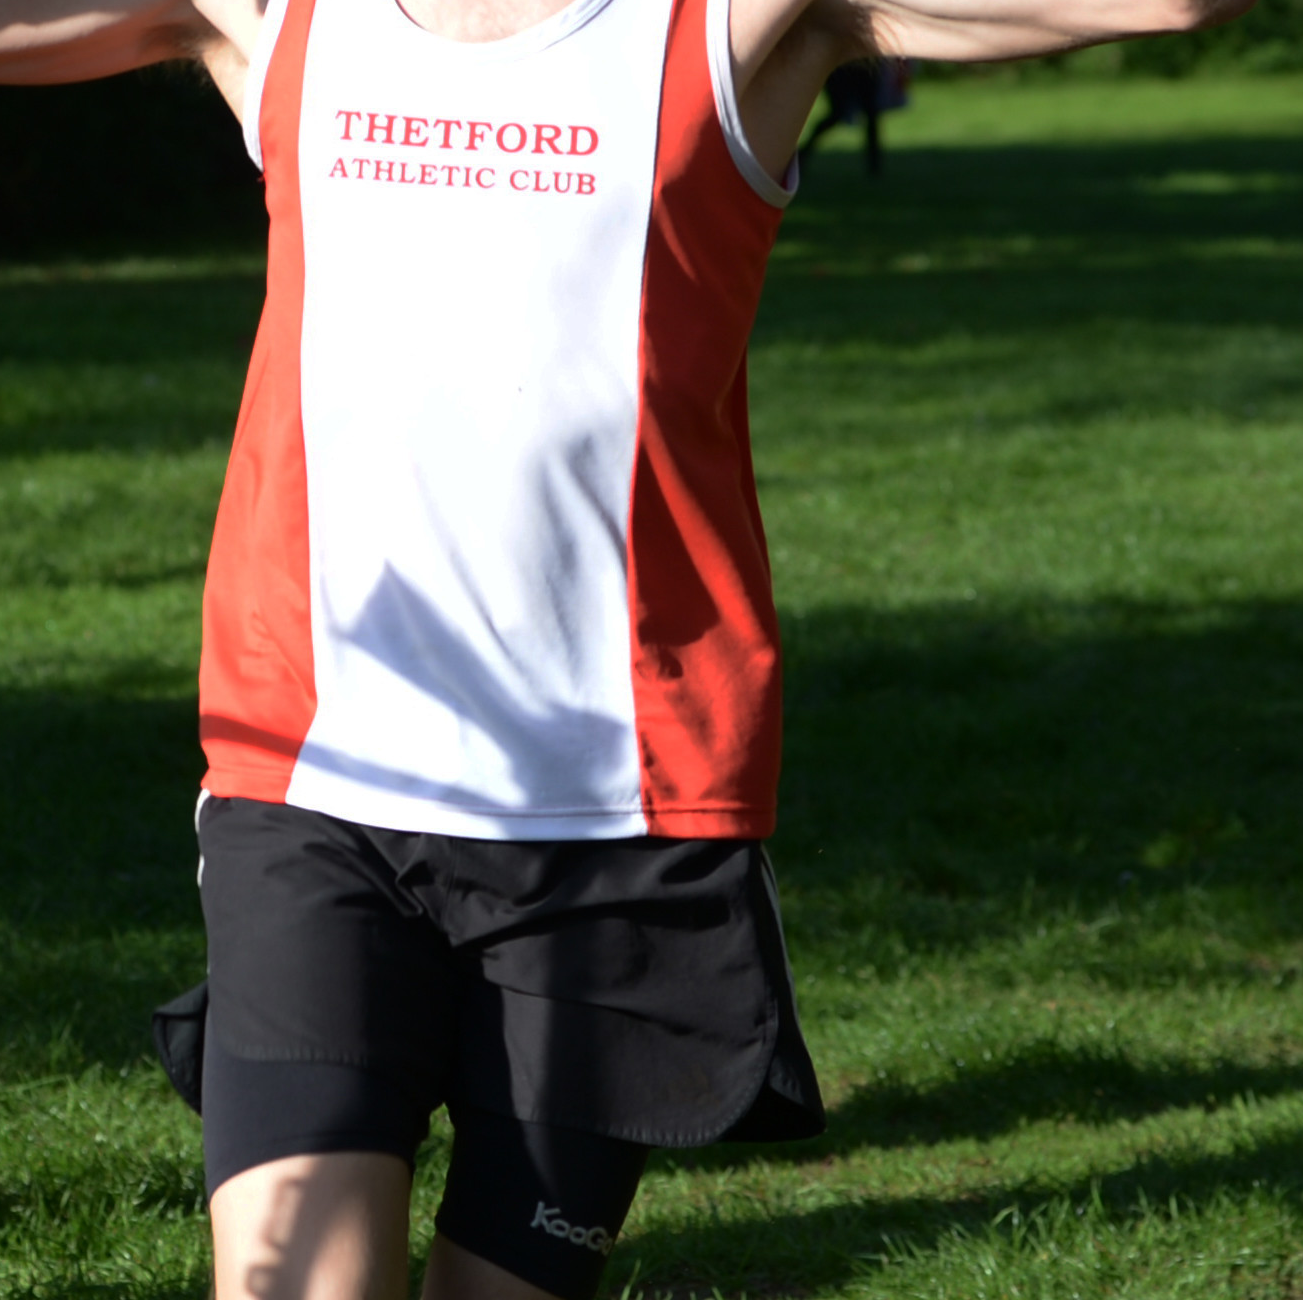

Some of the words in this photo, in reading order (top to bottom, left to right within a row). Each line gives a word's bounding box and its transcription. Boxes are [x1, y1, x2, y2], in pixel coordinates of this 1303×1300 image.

[335, 110, 599, 156] THETFORD
[328, 157, 496, 189] ATHLETIC
[509, 169, 596, 195] CLUB
